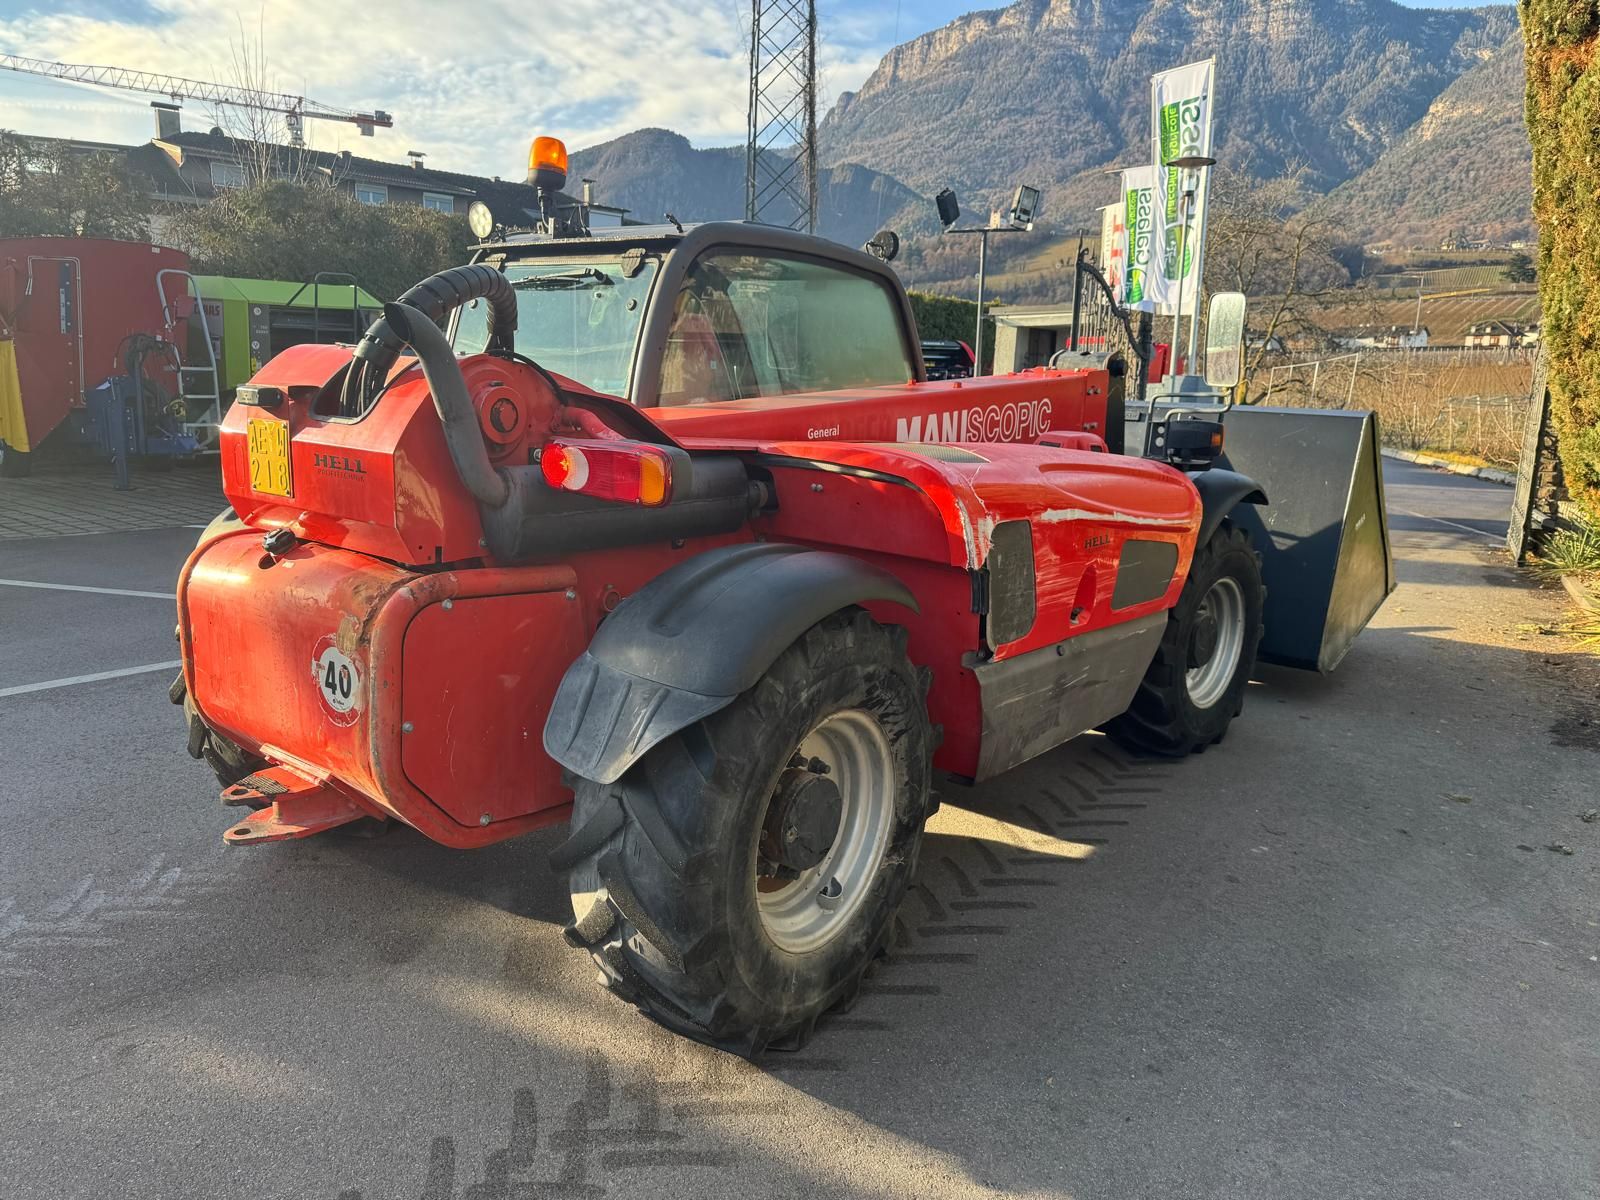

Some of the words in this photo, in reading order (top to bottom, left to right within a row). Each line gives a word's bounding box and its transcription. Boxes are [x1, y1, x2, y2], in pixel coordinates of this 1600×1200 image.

[807, 424, 840, 439] General
[896, 398, 1052, 443] MANISCOPIC
[252, 458, 288, 490] 218
[314, 452, 367, 474] HELL
[1085, 535, 1110, 549] HELL
[325, 661, 351, 698] 40
